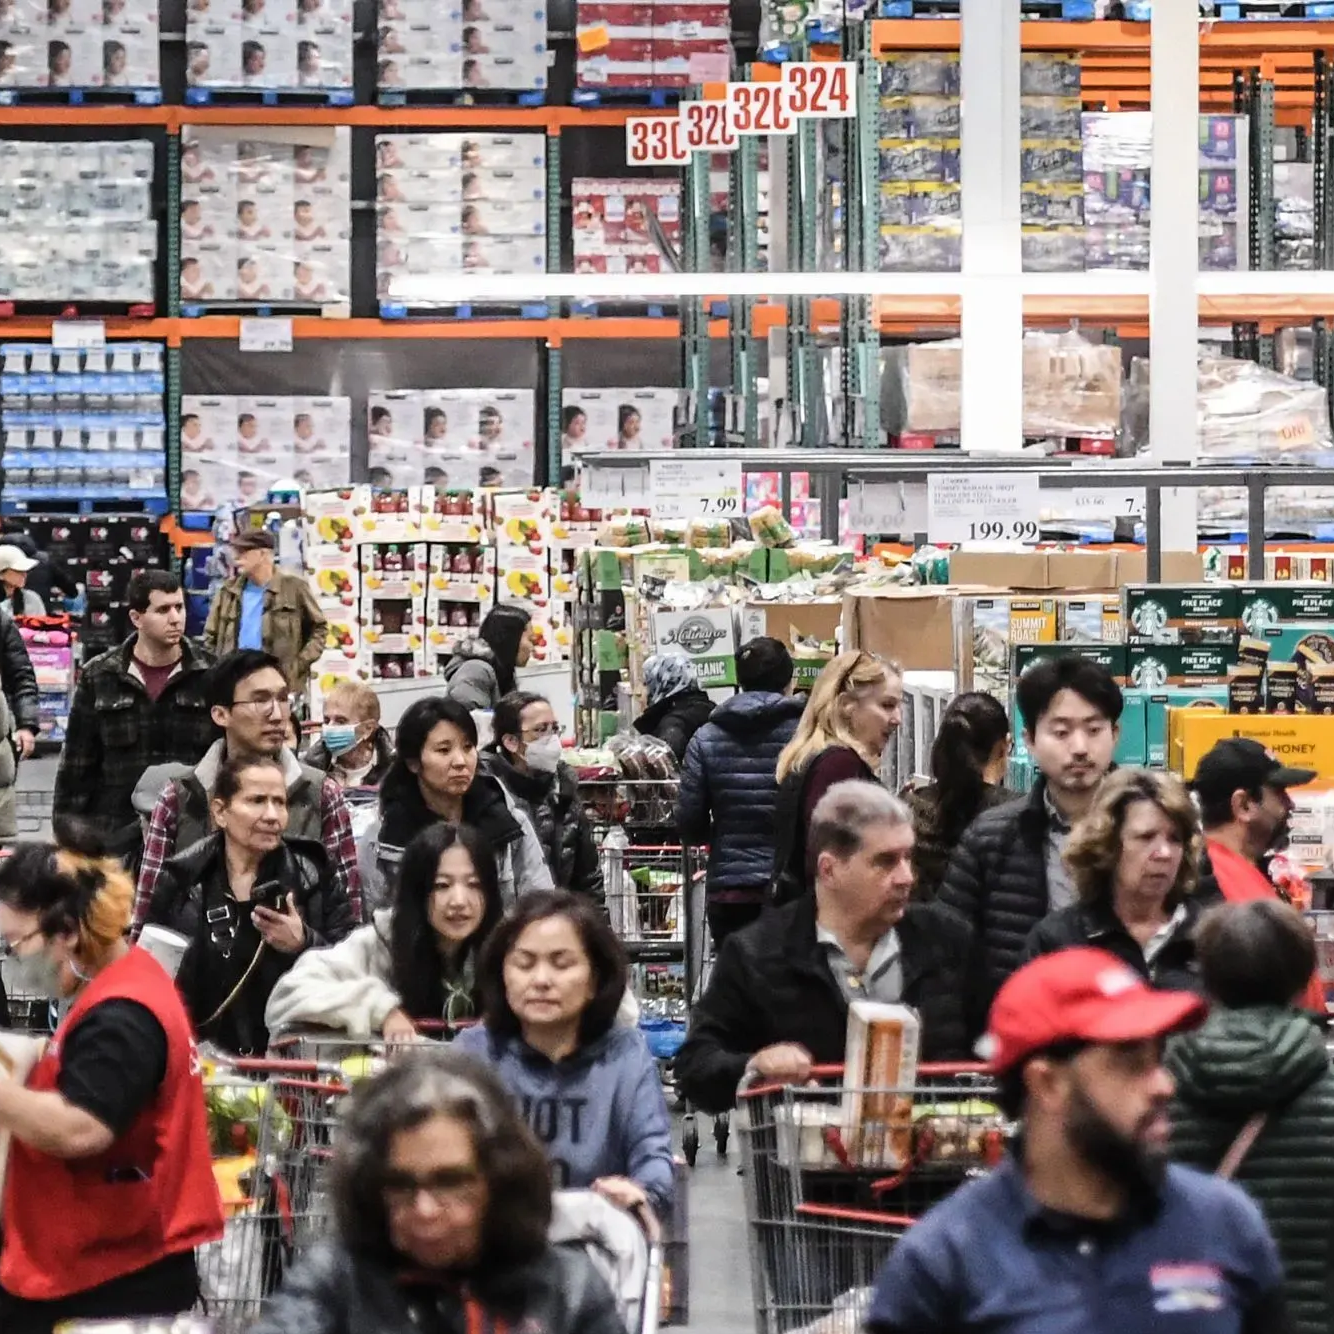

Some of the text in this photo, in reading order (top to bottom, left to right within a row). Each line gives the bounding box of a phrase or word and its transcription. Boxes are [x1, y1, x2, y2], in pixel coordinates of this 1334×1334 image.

[789, 67, 849, 112] 324
[700, 498, 737, 513] 7.99
[1125, 498, 1146, 513] 7.
[969, 521, 1037, 540] 199.99
[1181, 599, 1222, 607] PIKE PLACE
[1292, 599, 1333, 607] PIKE PLACE
[1010, 617, 1047, 629] SUMMIT
[1010, 629, 1040, 641] ROAST
[1097, 657, 1113, 665] ACE
[1181, 657, 1222, 665] PIKE PLACE
[693, 661, 725, 676] RGANIC
[1272, 744, 1316, 754] HONEY
